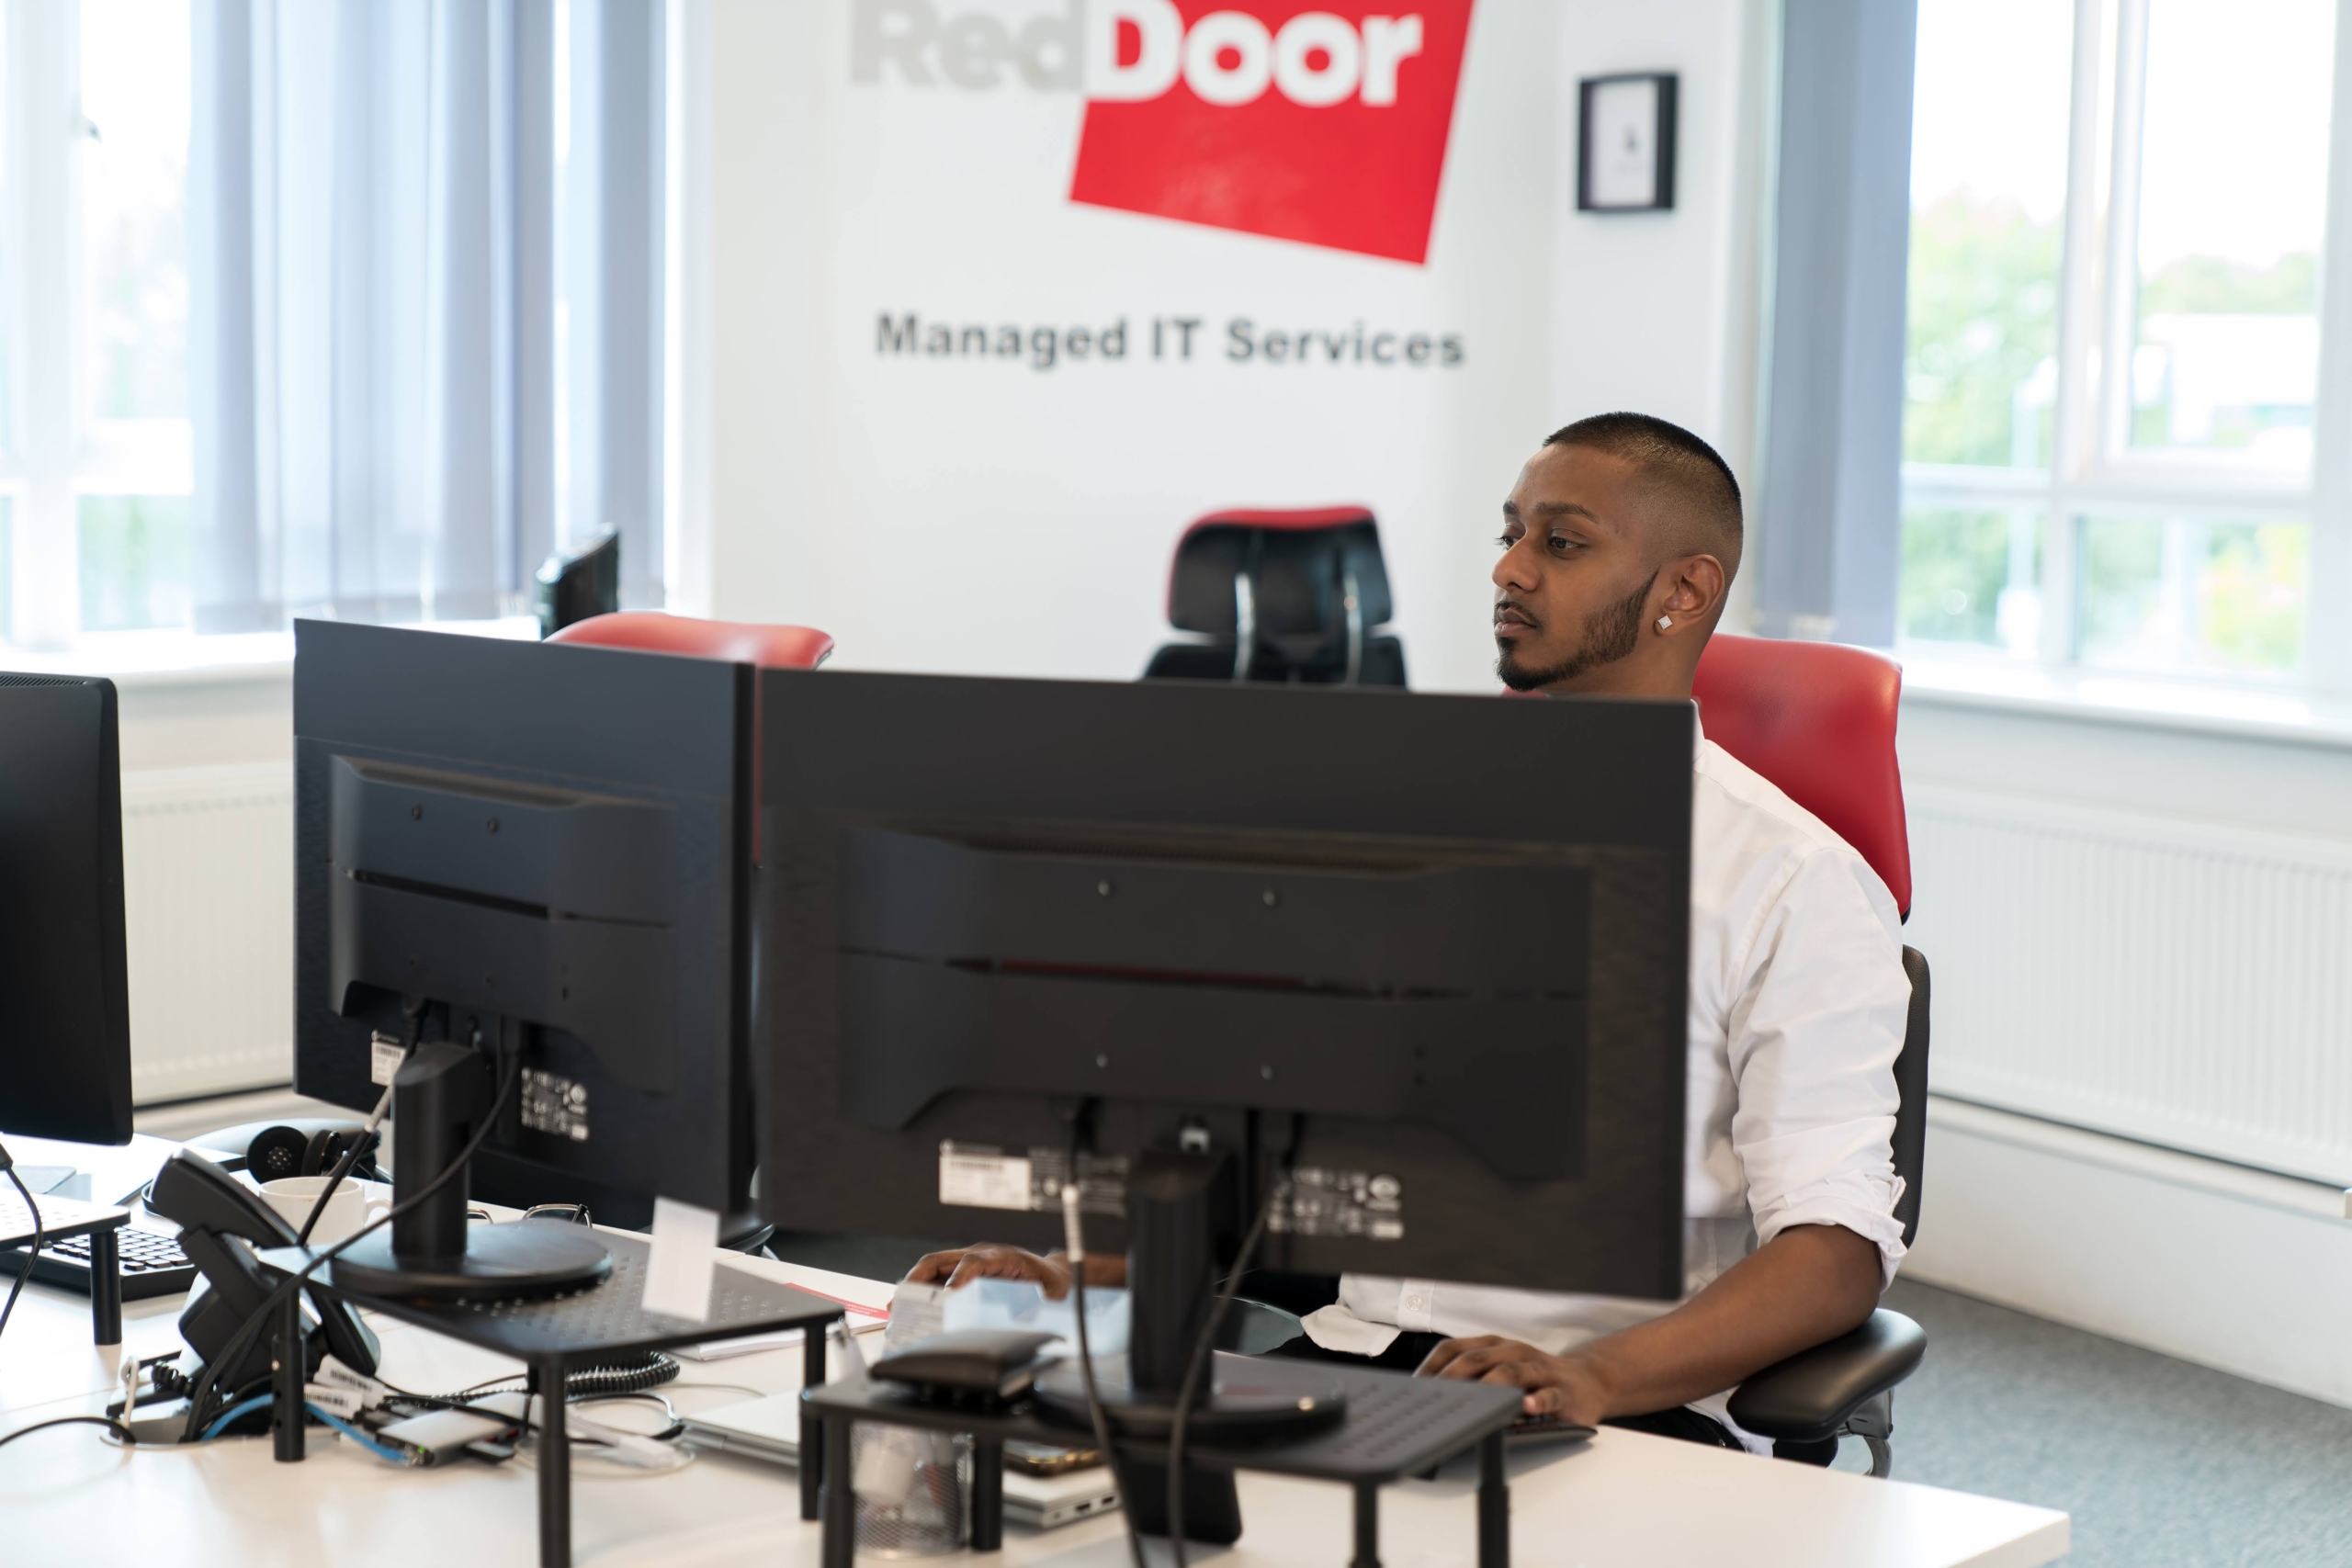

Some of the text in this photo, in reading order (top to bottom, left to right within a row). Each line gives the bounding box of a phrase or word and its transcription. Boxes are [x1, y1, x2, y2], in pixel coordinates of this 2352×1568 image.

[876, 313, 1466, 370] Managed IT Services
